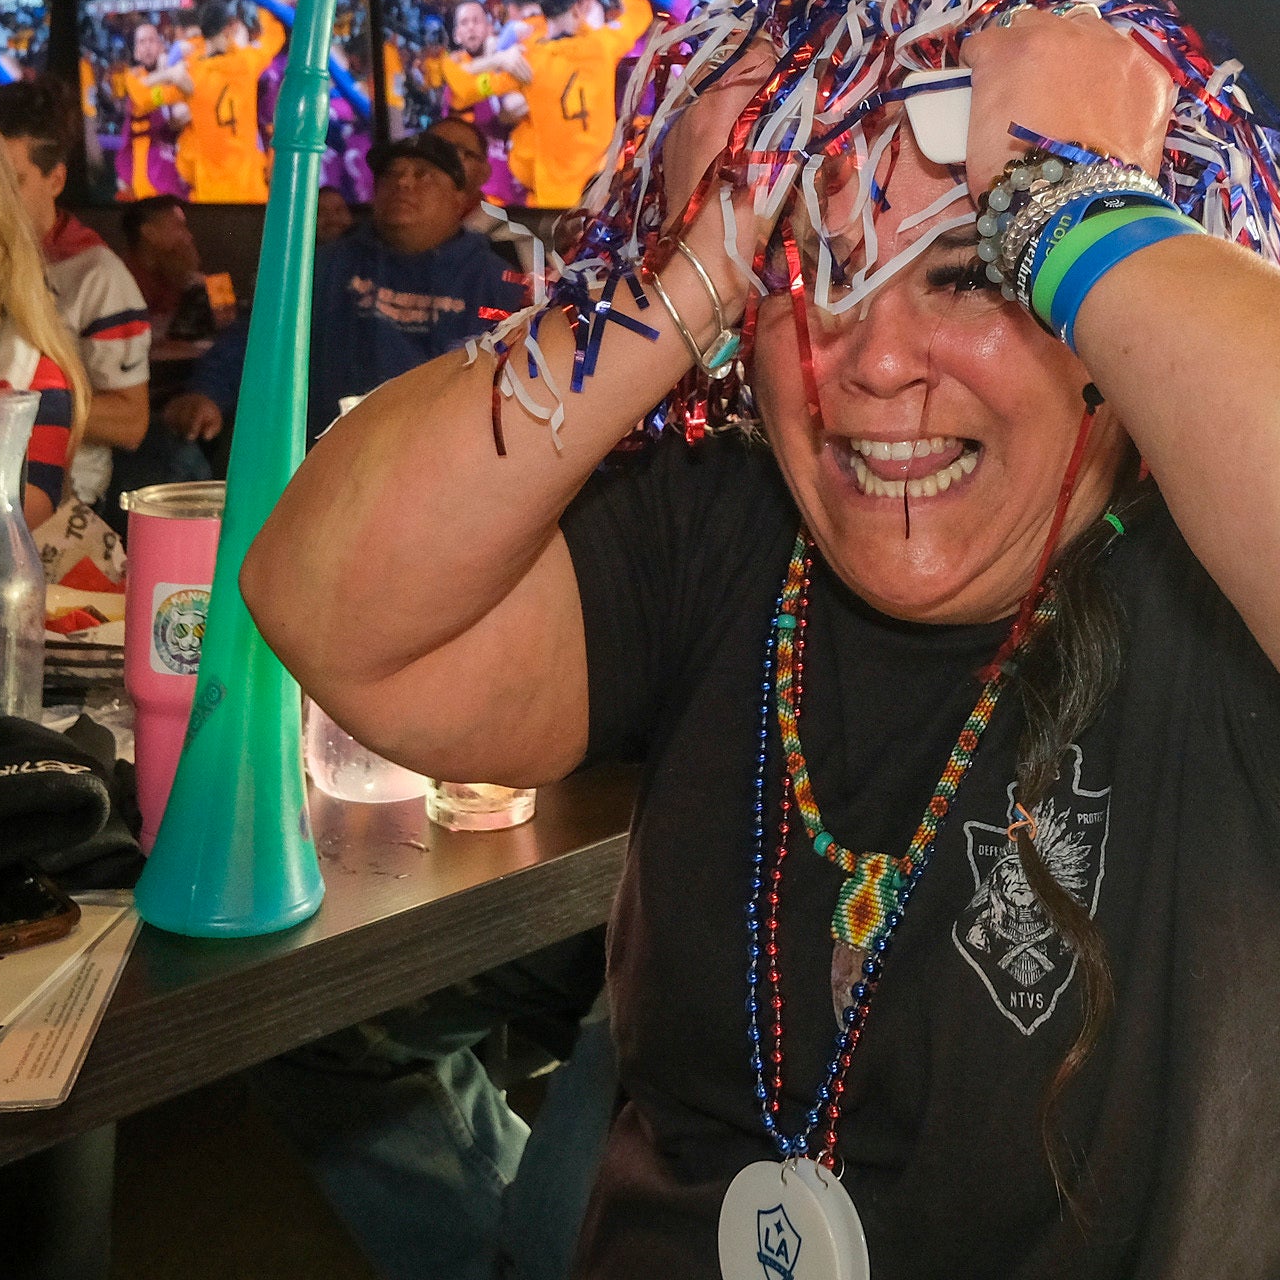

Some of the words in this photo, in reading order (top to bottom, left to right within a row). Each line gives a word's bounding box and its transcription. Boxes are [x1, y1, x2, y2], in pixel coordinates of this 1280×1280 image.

[213, 84, 237, 137] 4
[558, 69, 590, 132] 4
[1010, 991, 1045, 1009] NTVS
[764, 1226, 790, 1265] LA
